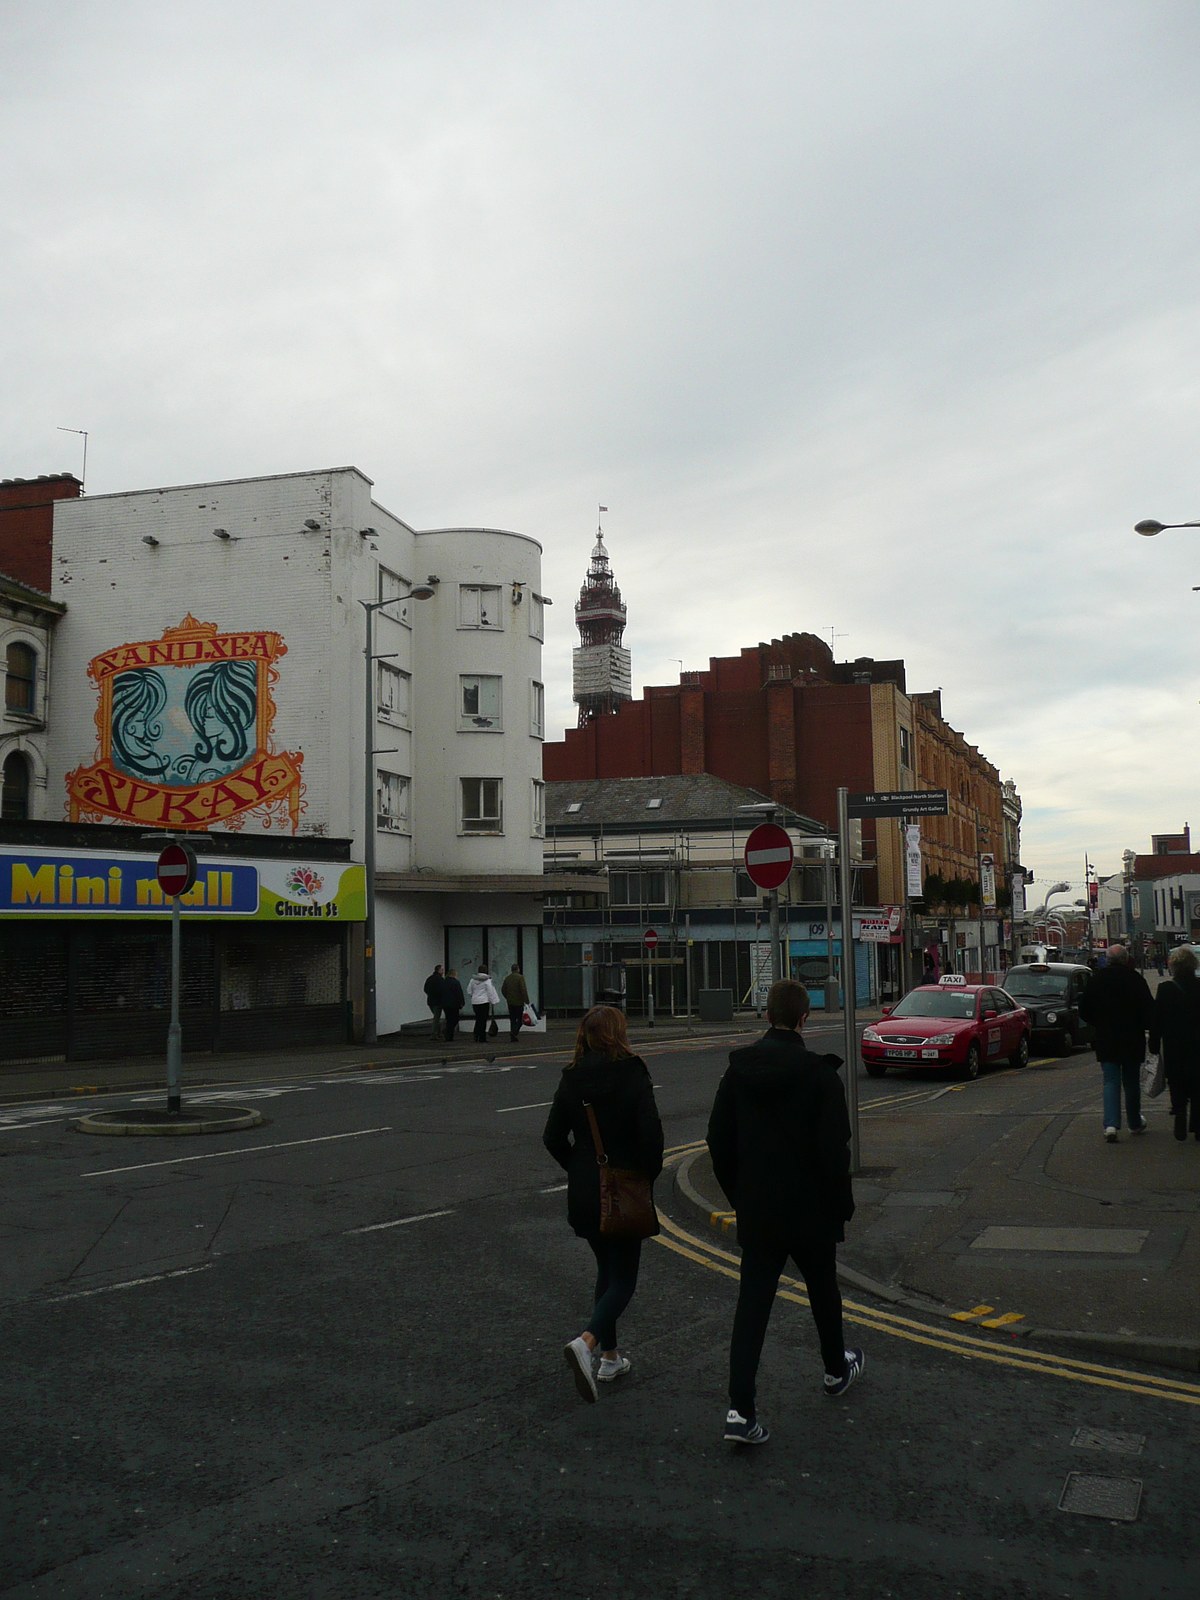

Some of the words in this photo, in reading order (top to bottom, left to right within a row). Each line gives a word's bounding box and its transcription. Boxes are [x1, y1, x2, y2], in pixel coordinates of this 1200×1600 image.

[84, 758, 272, 824] SPRAY
[11, 864, 122, 905] Mini
[275, 900, 323, 917] Church
[325, 901, 339, 918] St
[809, 923, 824, 939] 109
